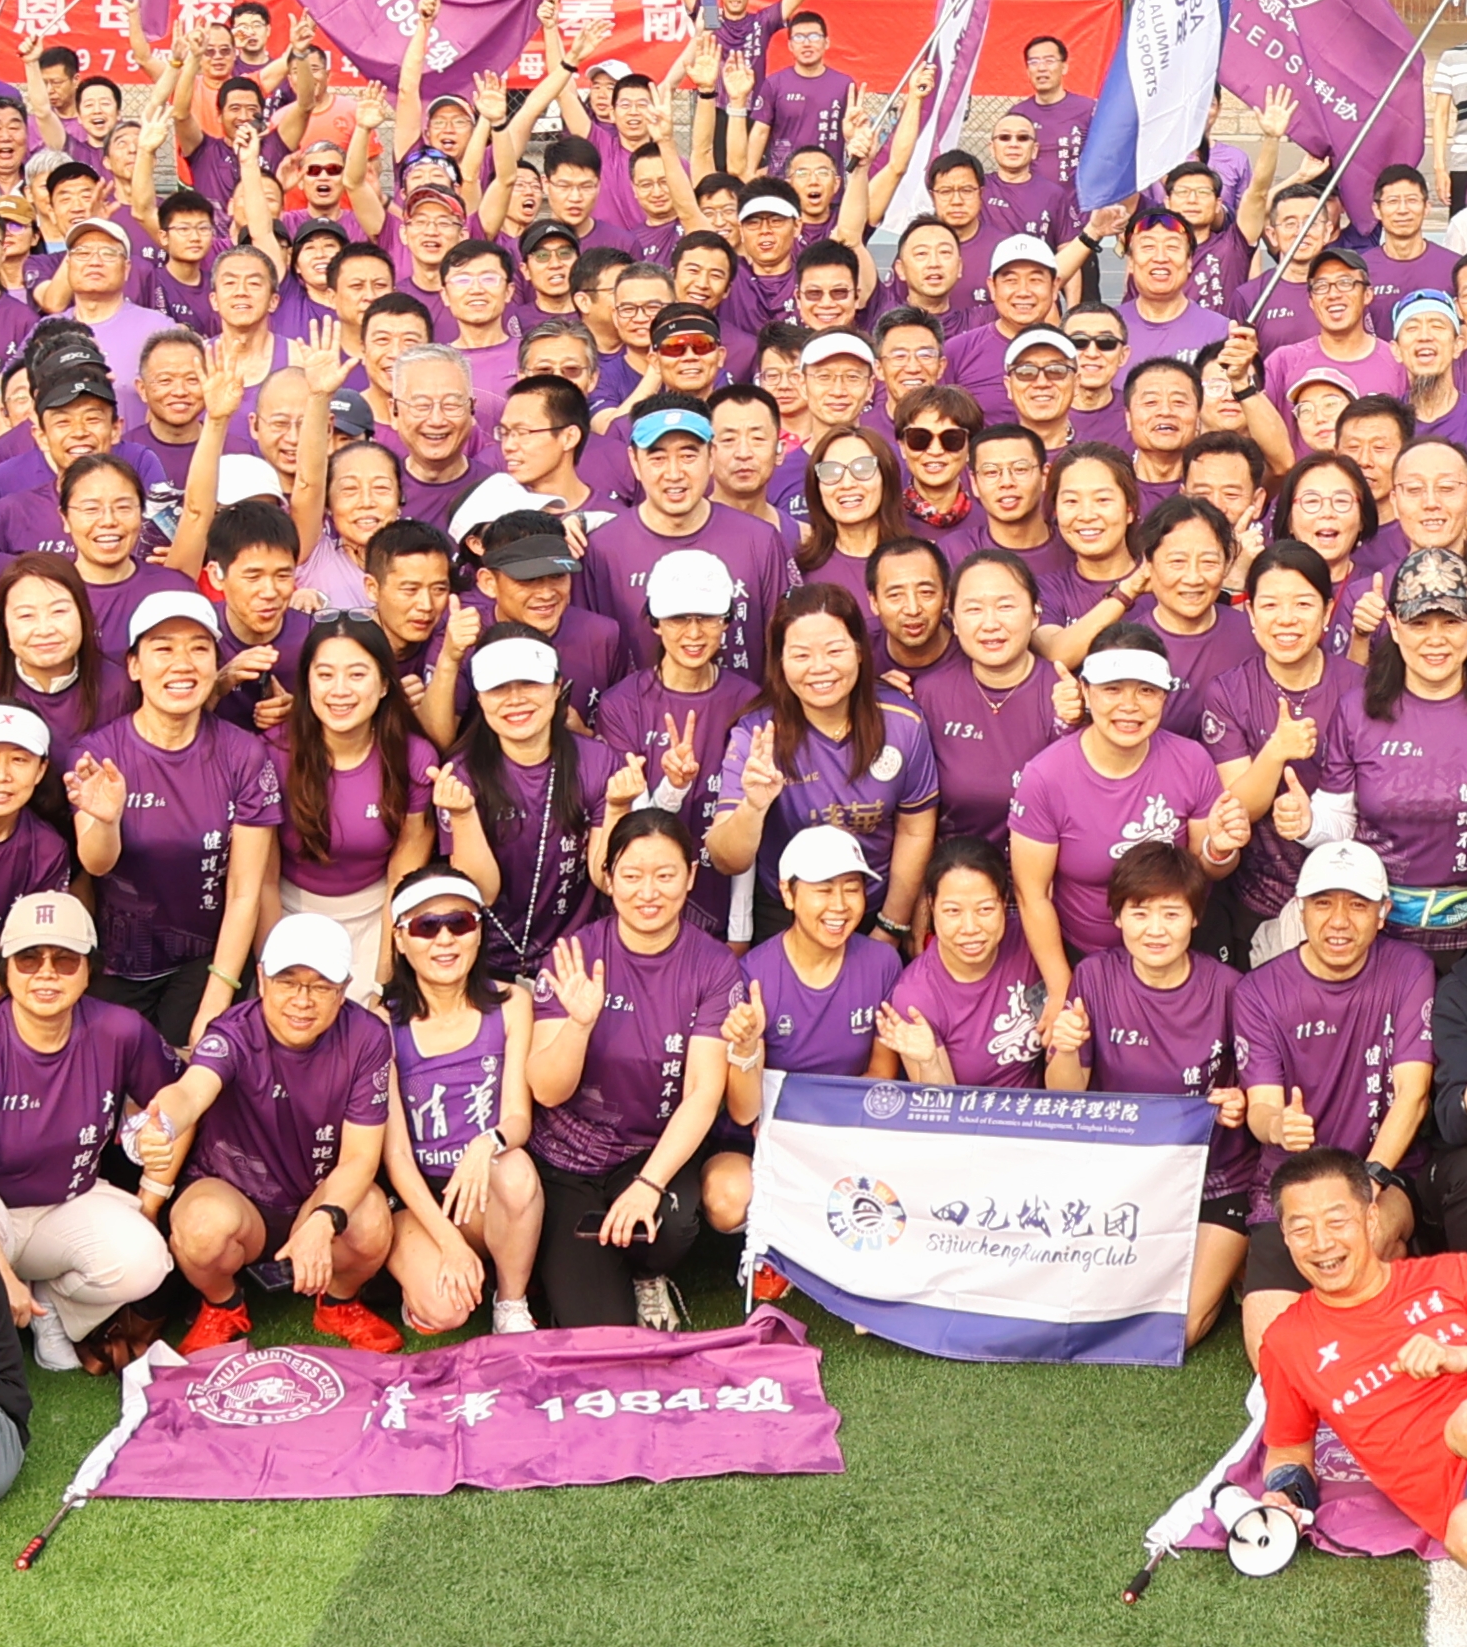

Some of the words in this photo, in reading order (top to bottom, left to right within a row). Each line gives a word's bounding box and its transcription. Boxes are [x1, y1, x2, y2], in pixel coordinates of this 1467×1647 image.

[1372, 285, 1400, 295] 113th
[1266, 309, 1294, 320] 113th
[37, 539, 76, 555] 113th
[943, 722, 983, 739] 113th
[1381, 741, 1422, 757] 113th
[127, 793, 166, 808] 113th
[197, 829, 222, 912] 健跑不息
[1109, 1027, 1148, 1045] 113th
[1295, 1024, 1336, 1038] 113th
[3, 1096, 40, 1110] 113th
[910, 1090, 954, 1109] SEM
[930, 1194, 1140, 1242] 四九城跑团
